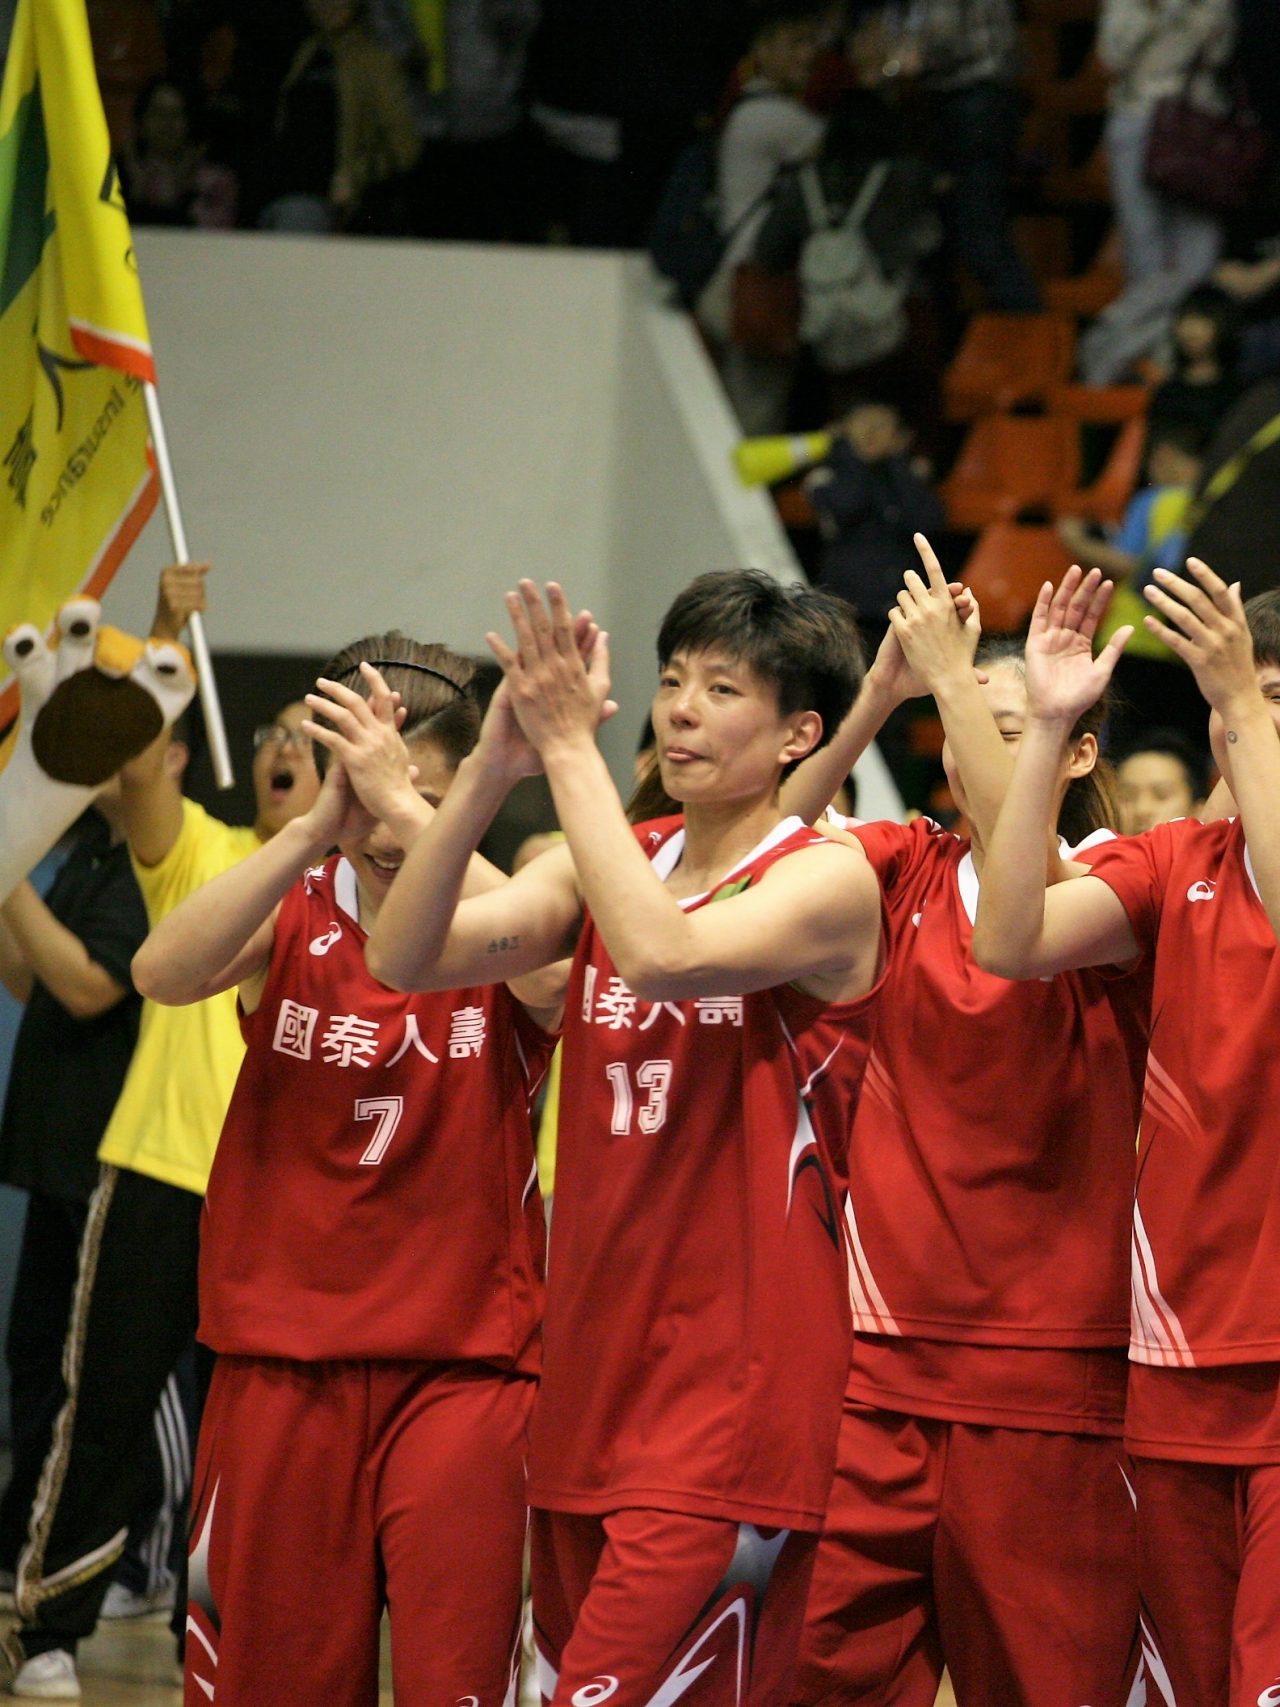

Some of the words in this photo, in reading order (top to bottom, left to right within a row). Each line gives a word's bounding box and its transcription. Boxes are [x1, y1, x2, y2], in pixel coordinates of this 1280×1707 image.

[272, 998, 486, 1068] 國泰人壽
[354, 1096, 404, 1166] 7
[606, 1060, 672, 1135] 13
